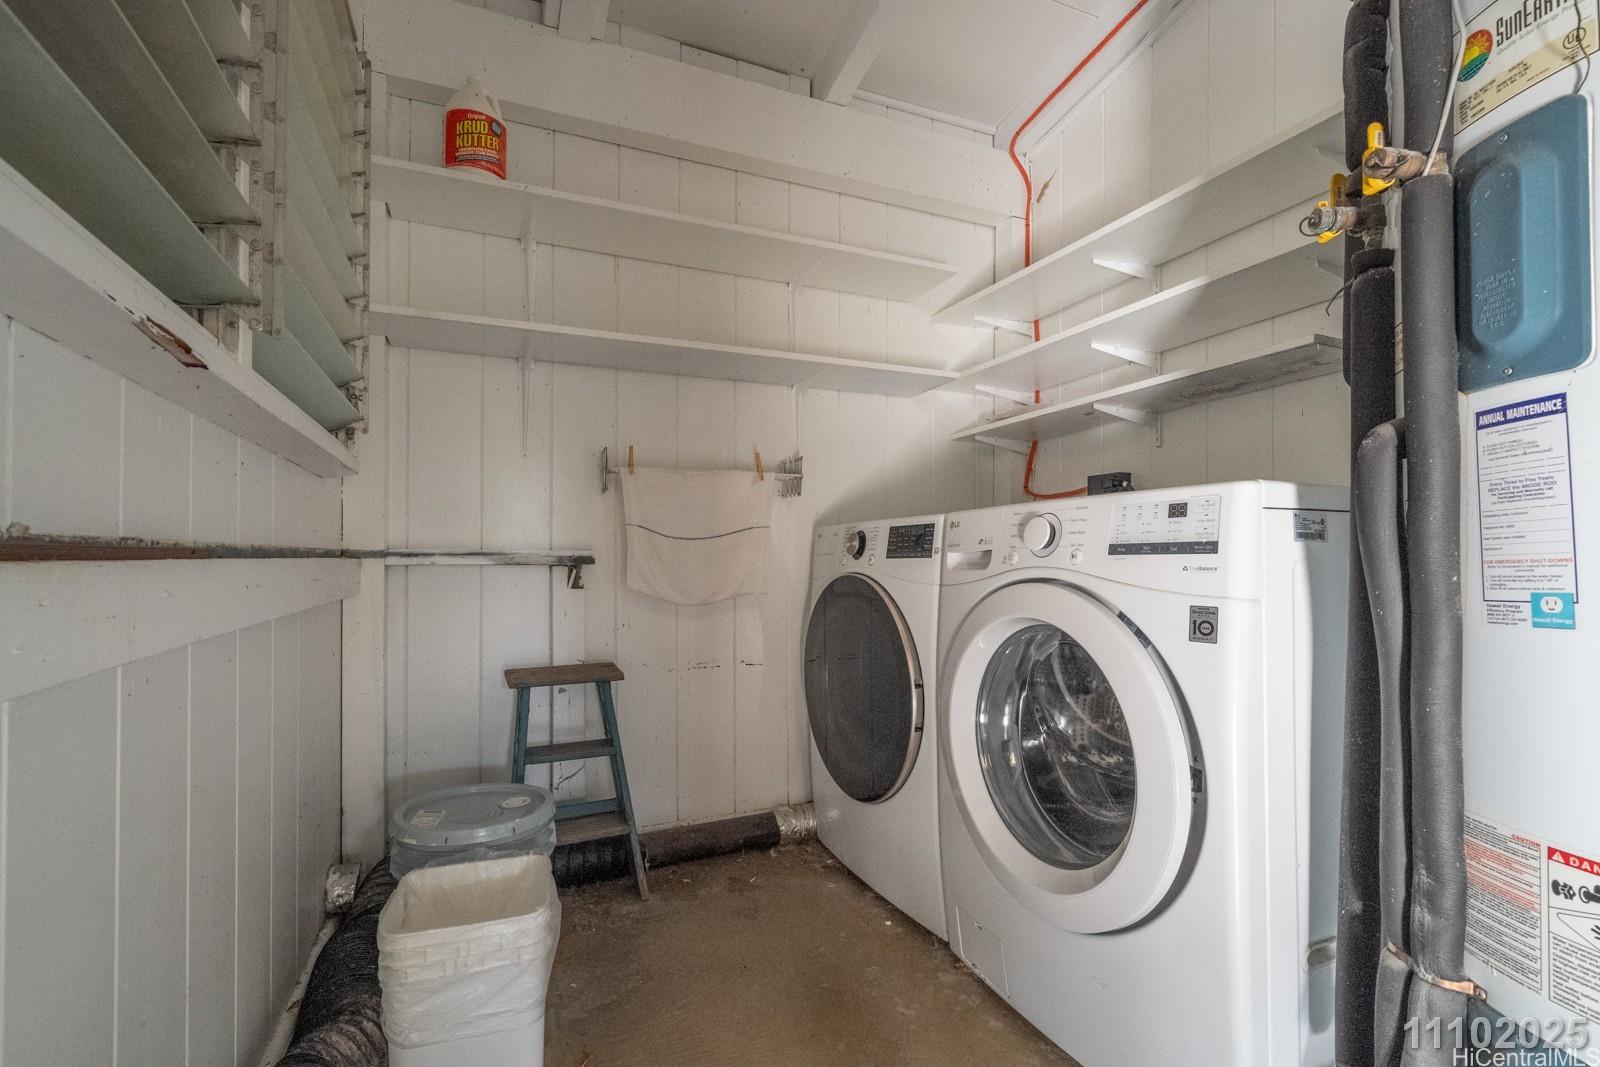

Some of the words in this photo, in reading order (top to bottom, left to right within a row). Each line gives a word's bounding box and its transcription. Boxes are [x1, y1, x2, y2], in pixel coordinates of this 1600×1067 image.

[468, 112, 486, 120] Original
[456, 120, 488, 134] KRUD
[456, 134, 499, 150] KUTTER
[1478, 411, 1504, 426] ANNUAL
[1506, 399, 1562, 420] MAINTENANCE
[1192, 620, 1214, 637] 10
[1512, 834, 1540, 848] CAUTION
